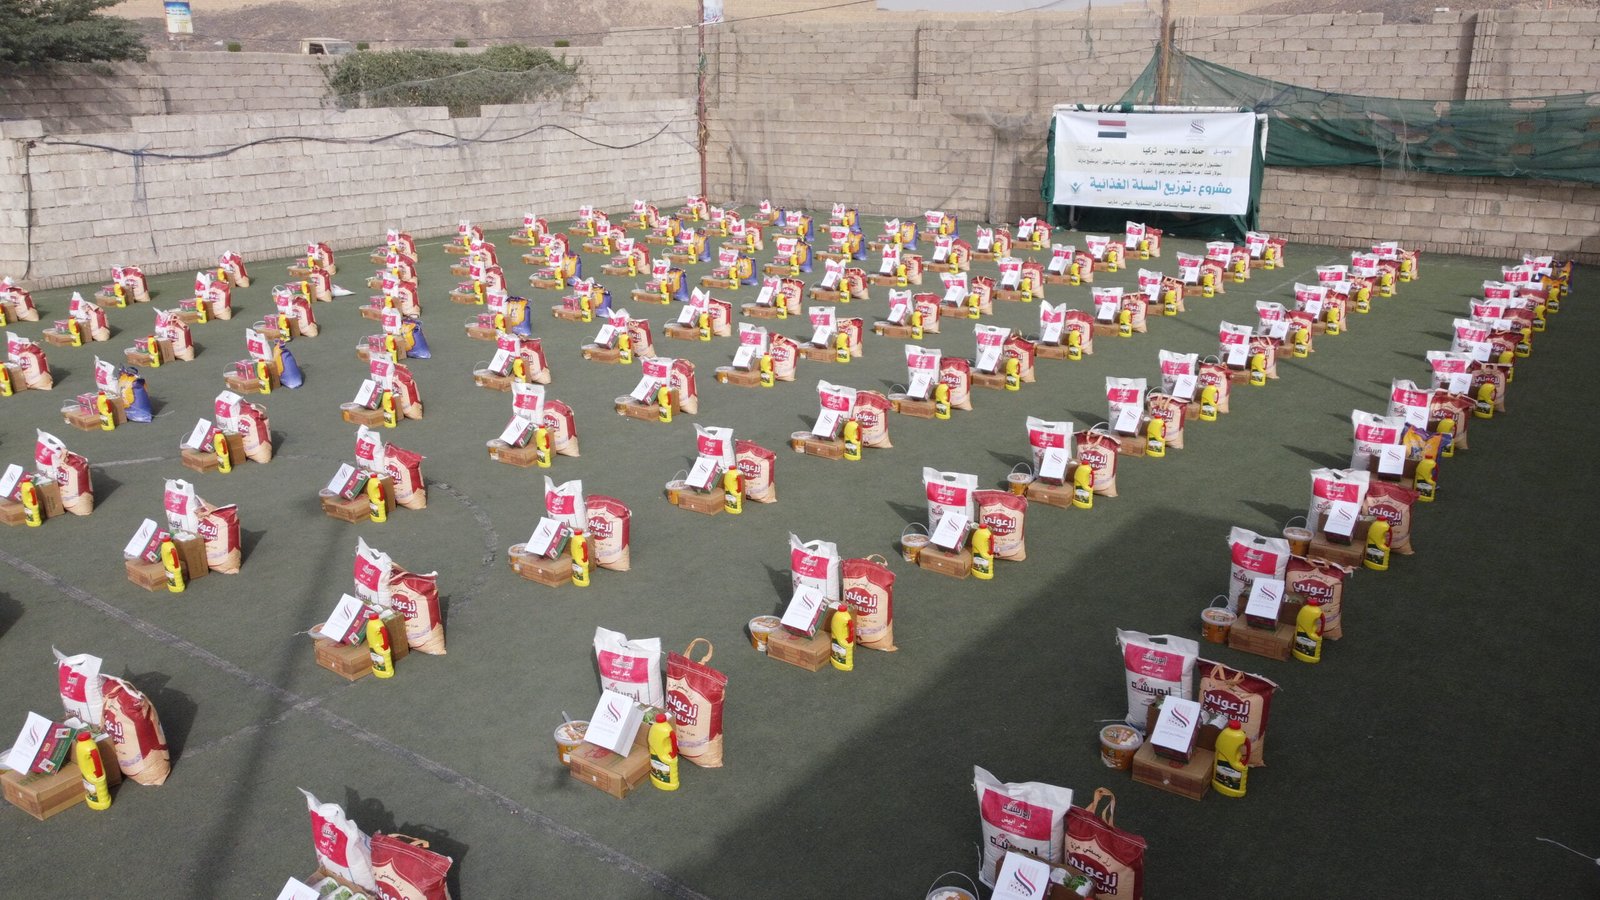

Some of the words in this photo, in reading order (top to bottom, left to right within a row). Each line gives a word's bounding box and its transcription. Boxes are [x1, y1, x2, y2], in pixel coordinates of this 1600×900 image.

[1090, 176, 1129, 192] الغذائية
[1132, 178, 1161, 191] السلة
[1163, 180, 1191, 196] توزيع
[1198, 182, 1232, 196] مشروع
[1293, 580, 1334, 598] زرعوني
[844, 589, 878, 608] زرعوني
[1203, 690, 1250, 717] زرعوني
